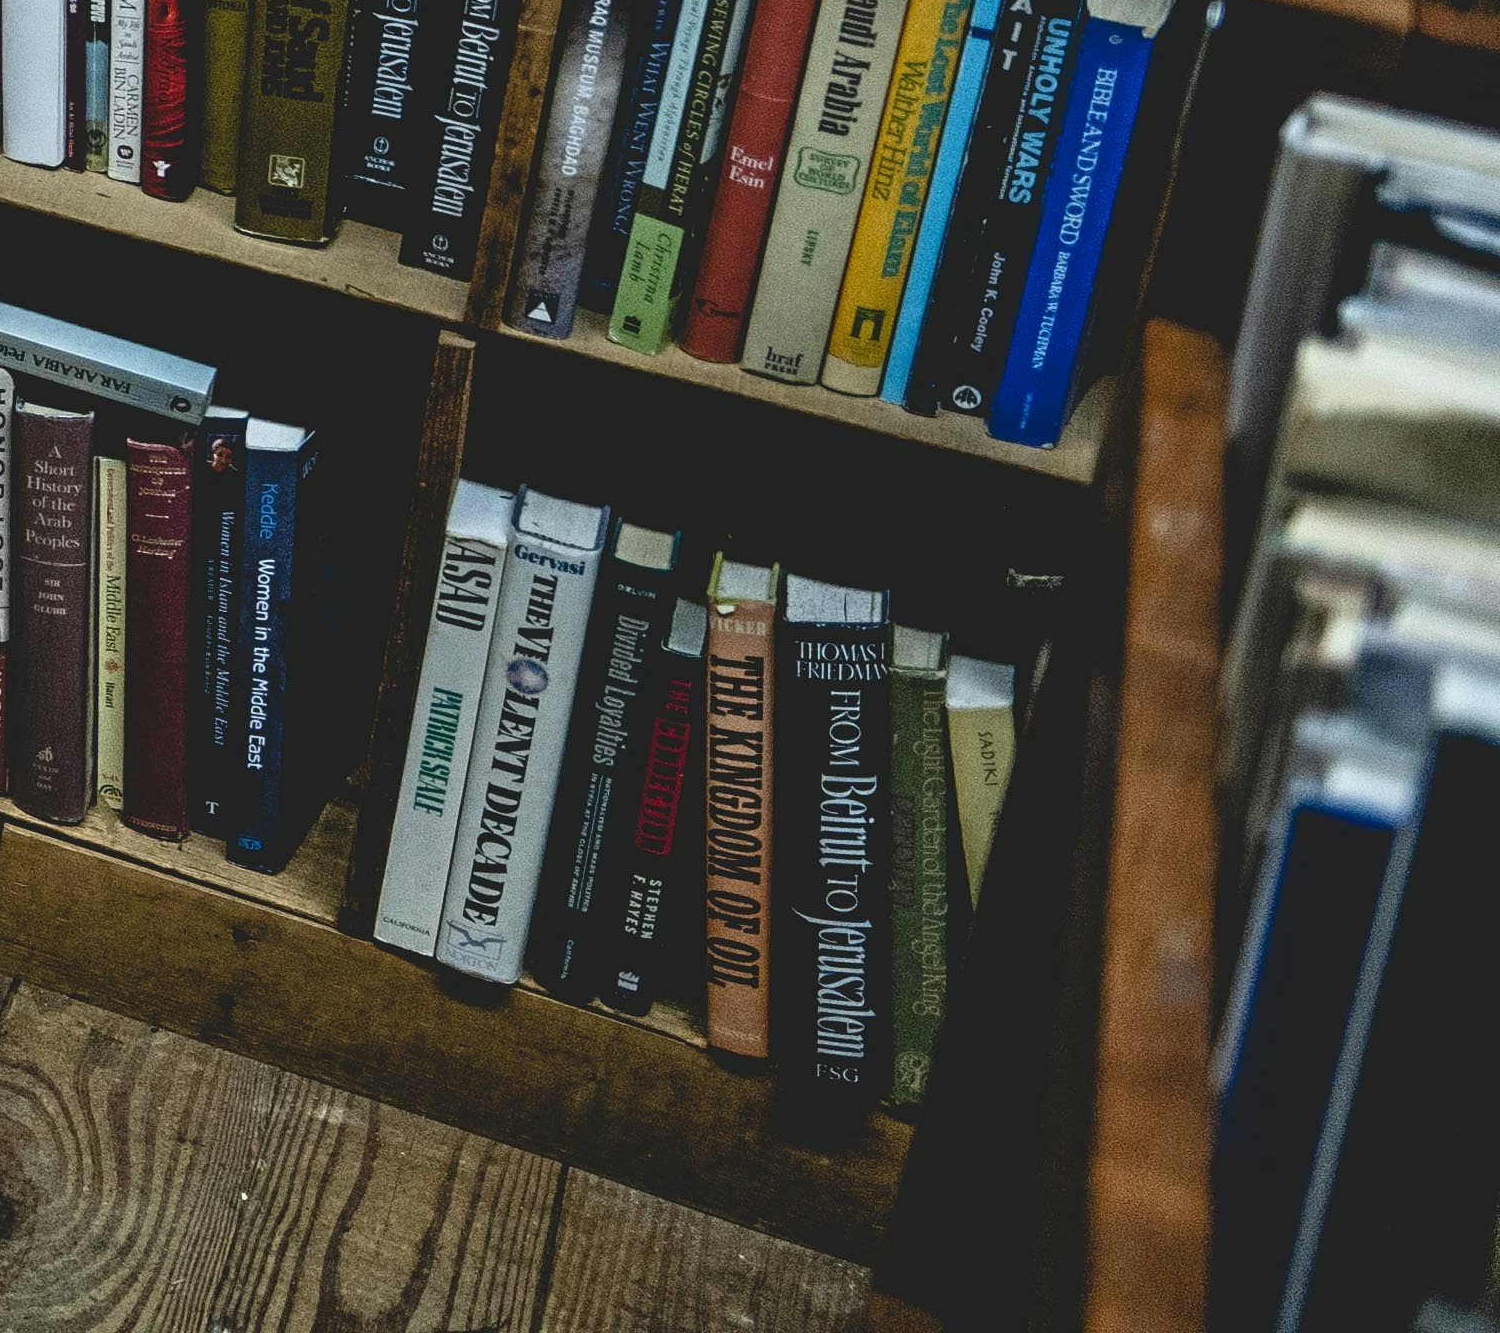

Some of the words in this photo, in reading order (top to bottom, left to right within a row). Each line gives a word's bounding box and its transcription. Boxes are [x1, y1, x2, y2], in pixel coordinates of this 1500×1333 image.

[819, 52, 871, 137] Arabia
[1024, 16, 1072, 124] UNHOLY
[728, 165, 765, 190] Esin
[731, 146, 774, 171] Emel
[1009, 131, 1047, 204] WARS
[106, 576, 122, 620] Middle
[105, 626, 121, 653] East
[829, 690, 861, 765] FROM
[978, 732, 998, 786] SADIKI
[463, 783, 522, 927] DECADE
[819, 774, 877, 872] Beirut
[826, 887, 856, 911] TO
[795, 911, 875, 1057] Jerusalem
